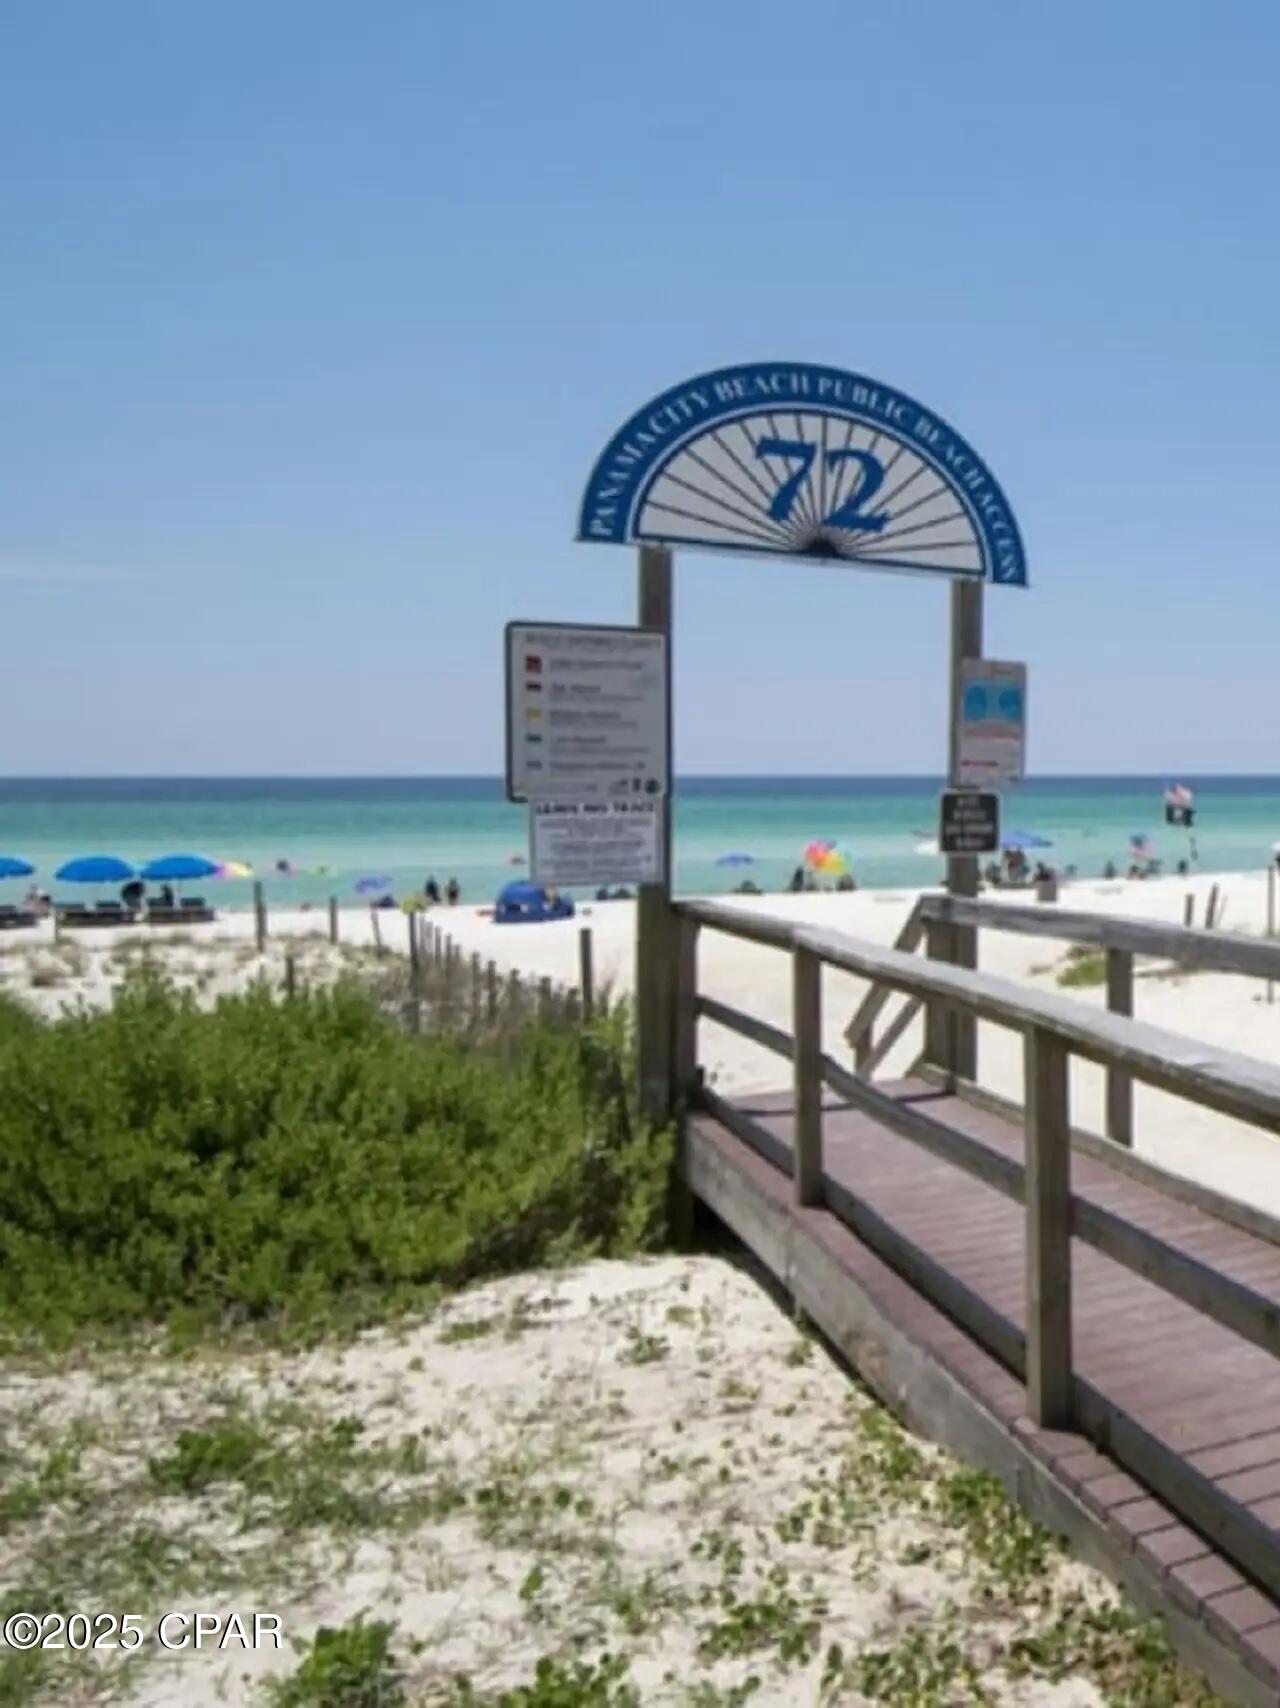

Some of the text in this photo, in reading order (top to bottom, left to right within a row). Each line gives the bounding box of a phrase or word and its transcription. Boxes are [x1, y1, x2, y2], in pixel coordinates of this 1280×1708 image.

[589, 430, 657, 536] PANAMA
[648, 389, 710, 434] CITY
[713, 372, 810, 401] BEACH
[817, 376, 908, 420] PUBLIC
[913, 415, 986, 489] BEACH
[756, 434, 889, 534] 72
